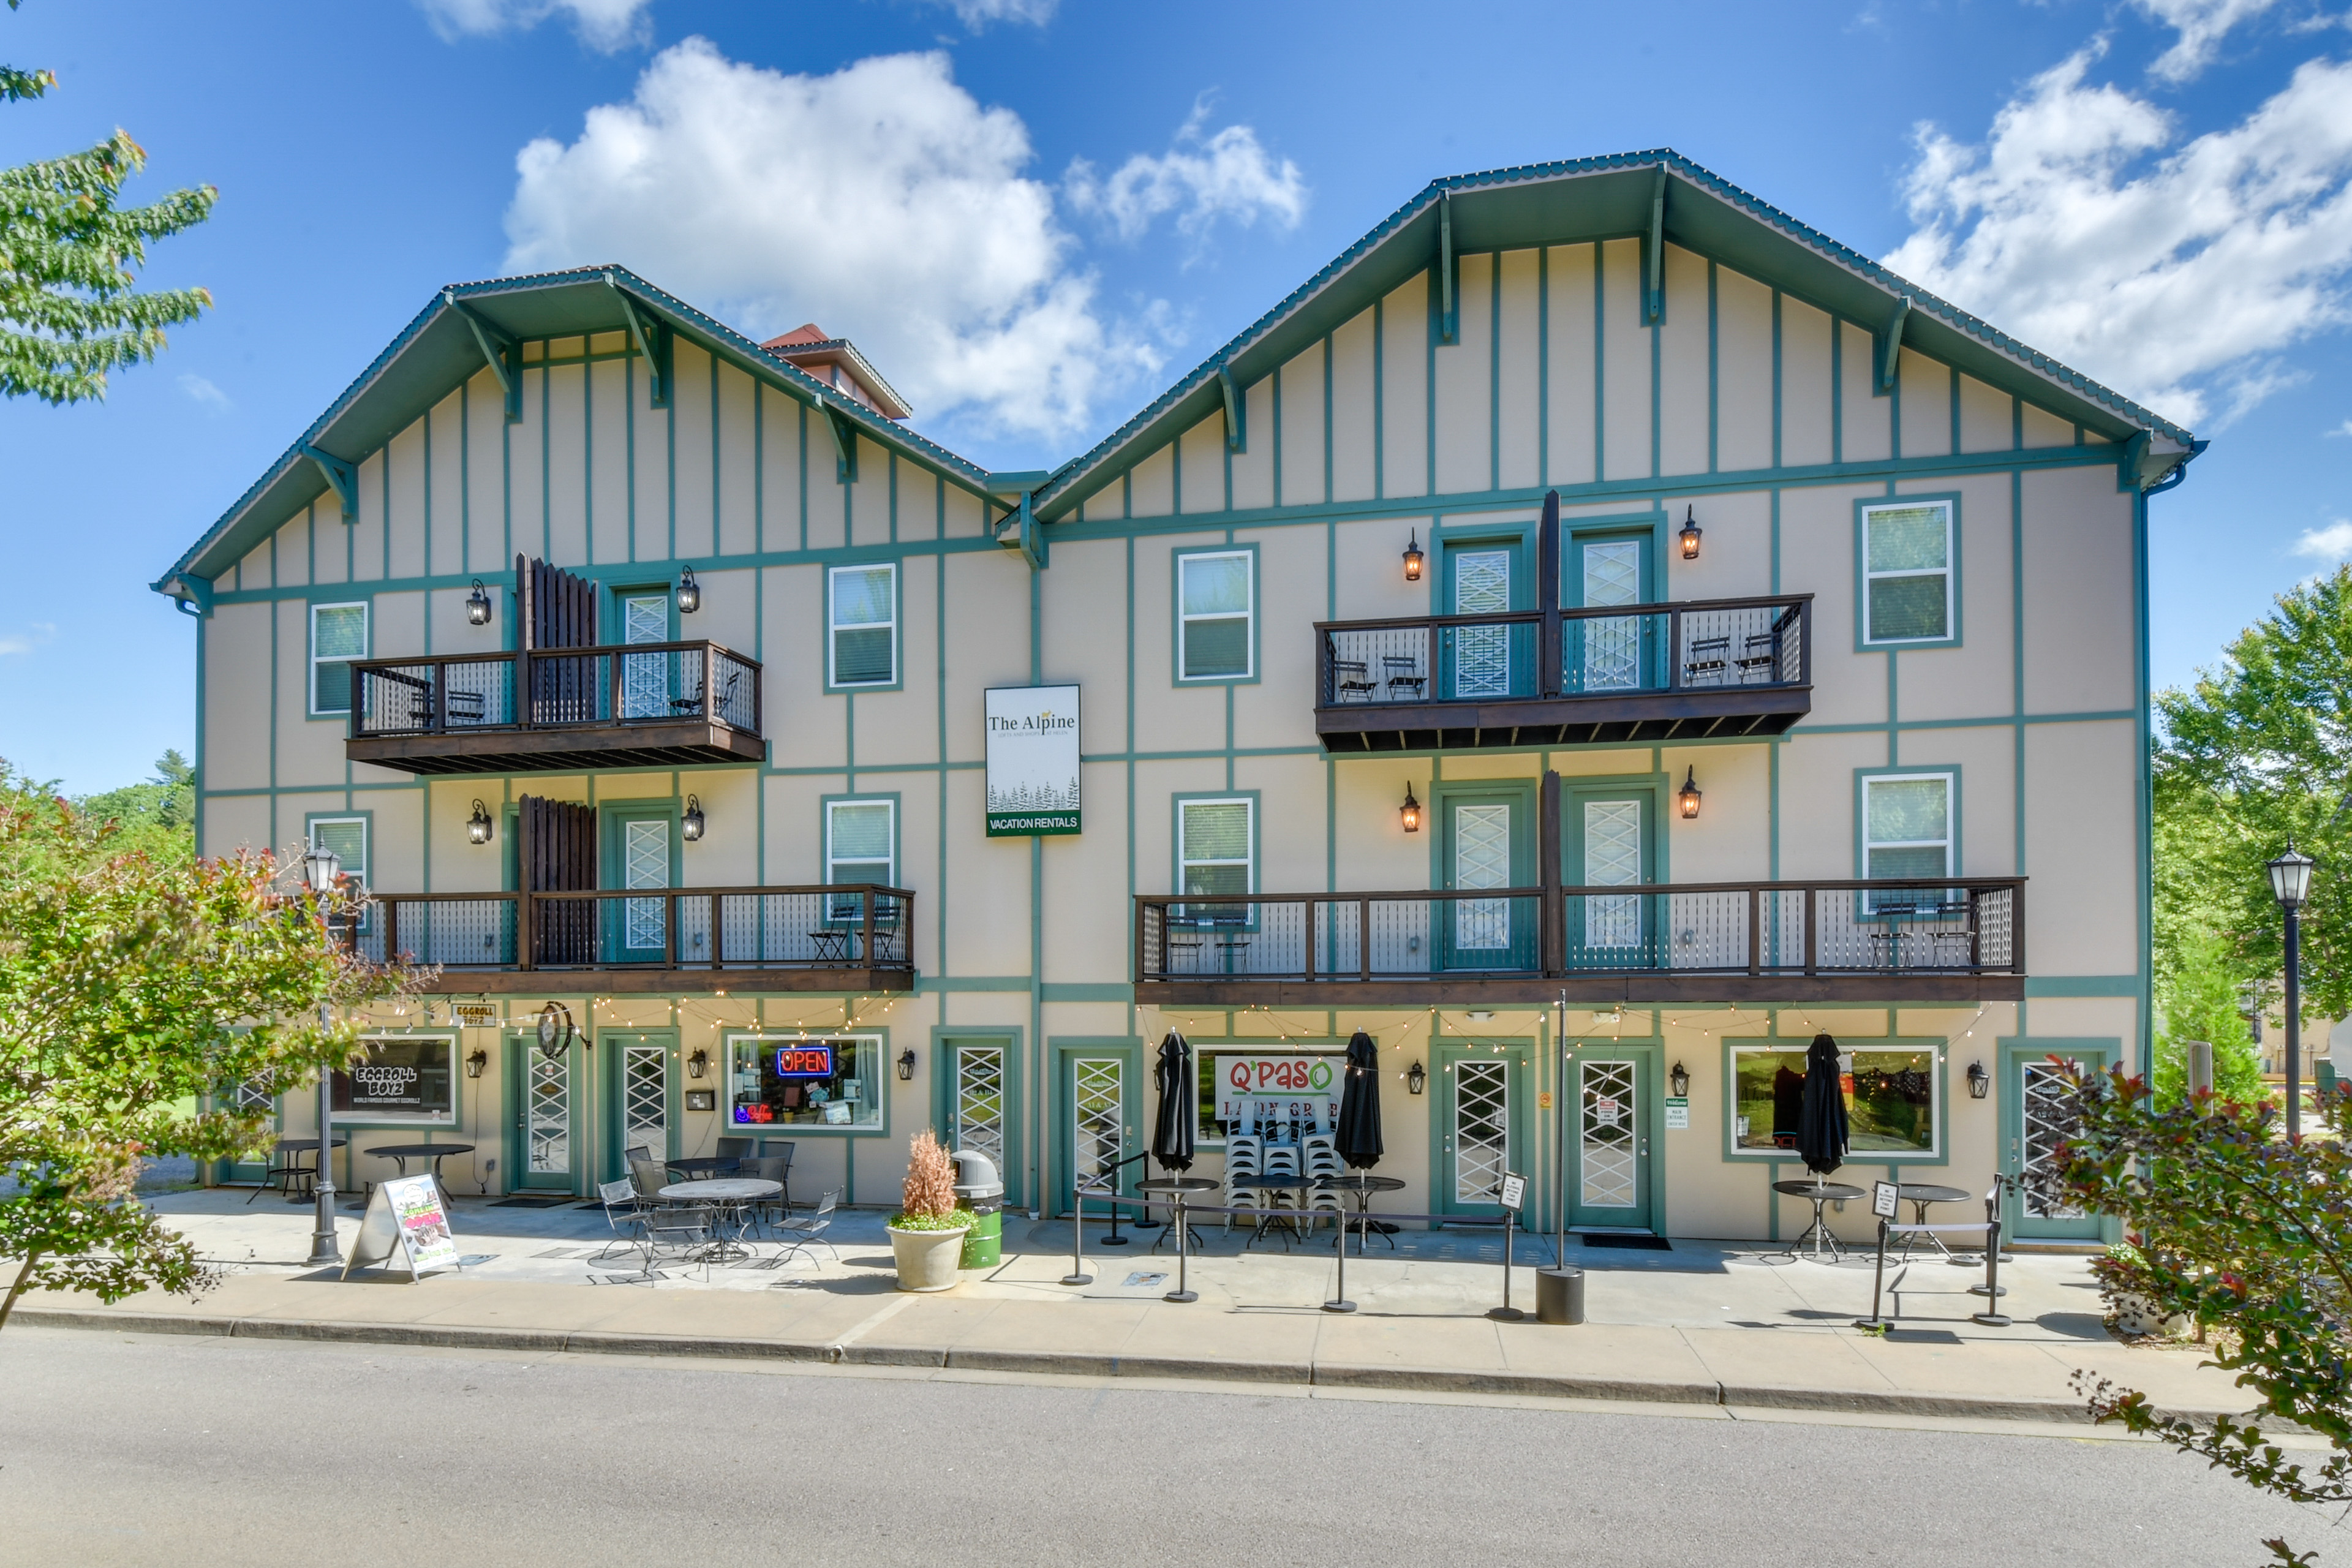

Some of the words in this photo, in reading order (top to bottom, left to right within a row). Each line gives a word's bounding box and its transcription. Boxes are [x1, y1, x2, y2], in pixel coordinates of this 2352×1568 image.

[989, 717, 1017, 730] The
[1022, 714, 1074, 735] Alpine
[990, 818, 1035, 829] VACATION
[1036, 816, 1077, 828] RENTALS
[457, 1006, 492, 1016] EGGROLL
[781, 1051, 827, 1072] OPEN
[356, 1067, 417, 1083] EGGROLL
[368, 1081, 404, 1096] BOYZ
[747, 1104, 773, 1123] Coffee
[1224, 1102, 1279, 1115] LIN
[1290, 1102, 1338, 1117] GRB
[404, 1207, 423, 1217] COME
[424, 1204, 434, 1213] IN
[405, 1212, 441, 1229] OPEN
